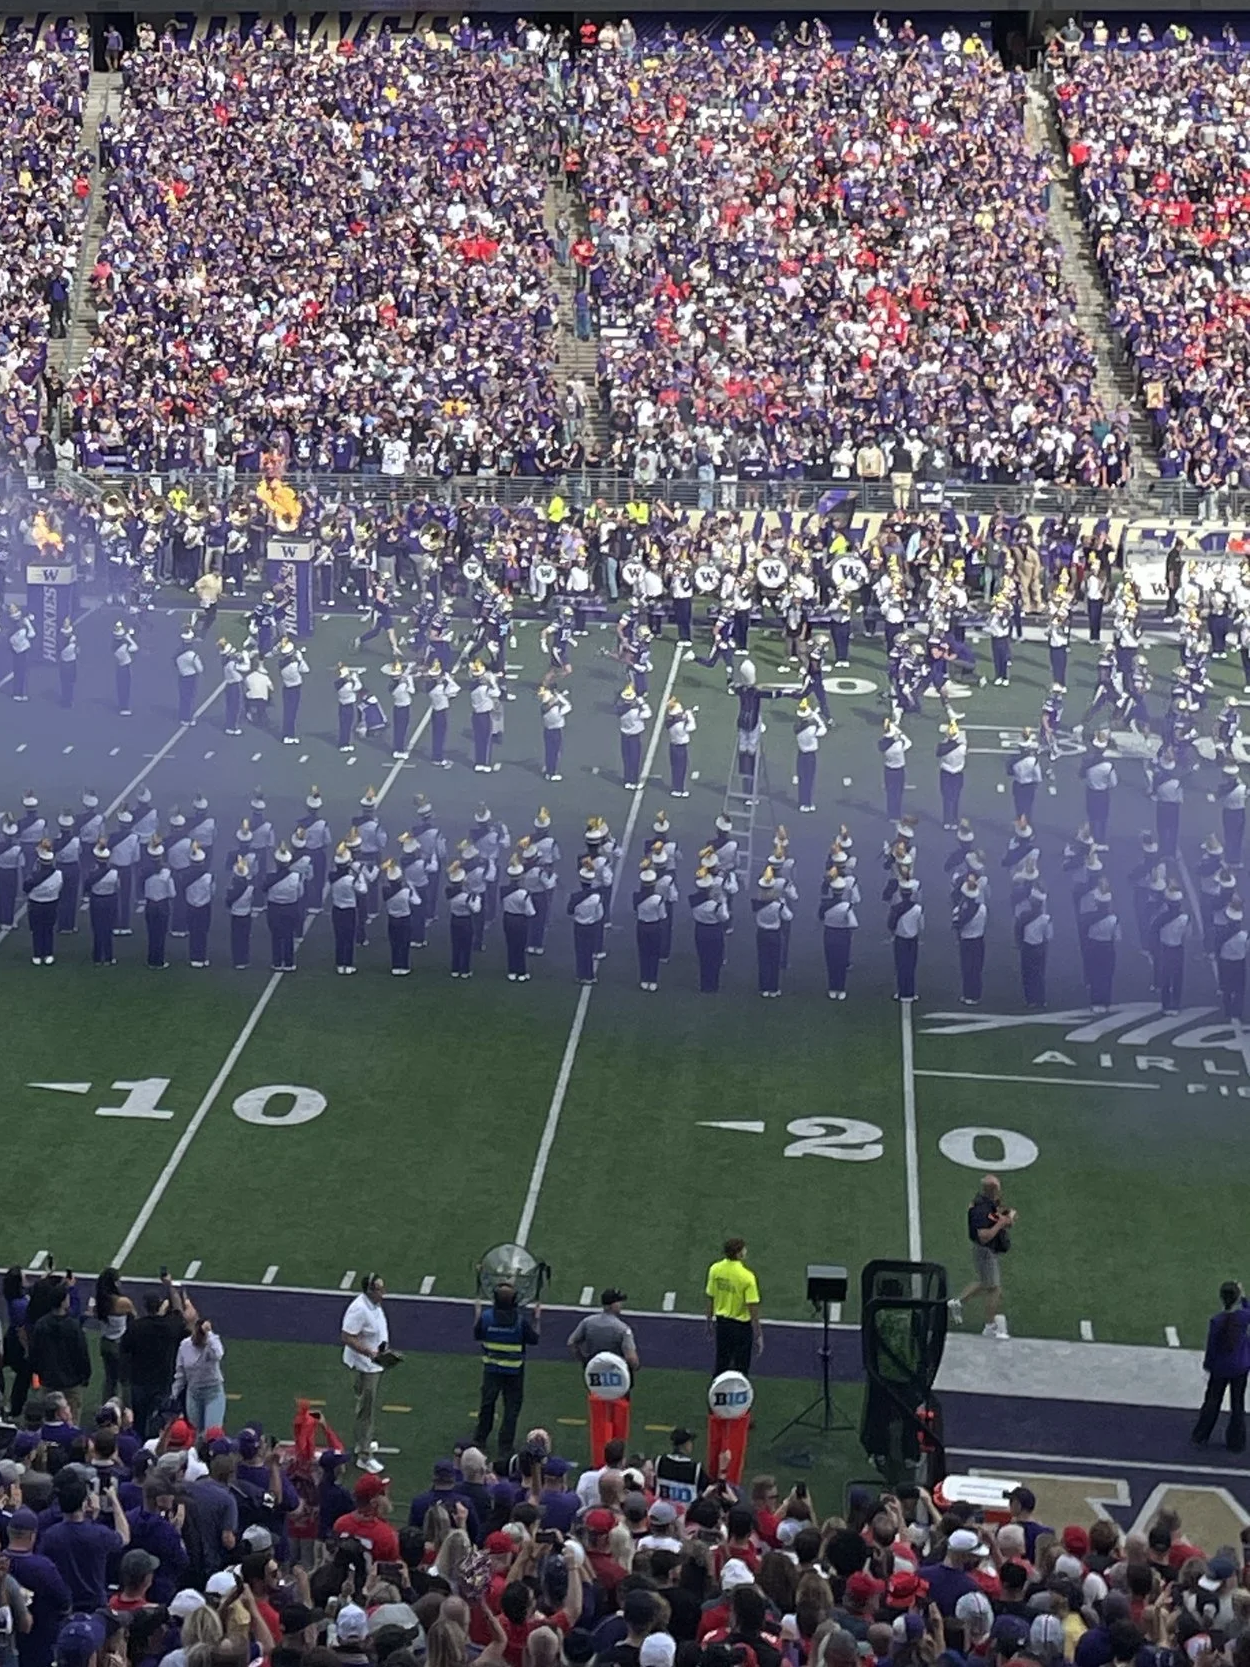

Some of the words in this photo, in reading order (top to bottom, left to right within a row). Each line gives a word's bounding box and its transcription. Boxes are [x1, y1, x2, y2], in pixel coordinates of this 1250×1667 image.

[281, 545, 299, 558] W
[43, 568, 59, 582] W
[762, 565, 781, 579] W
[43, 585, 58, 662] HUSKIES
